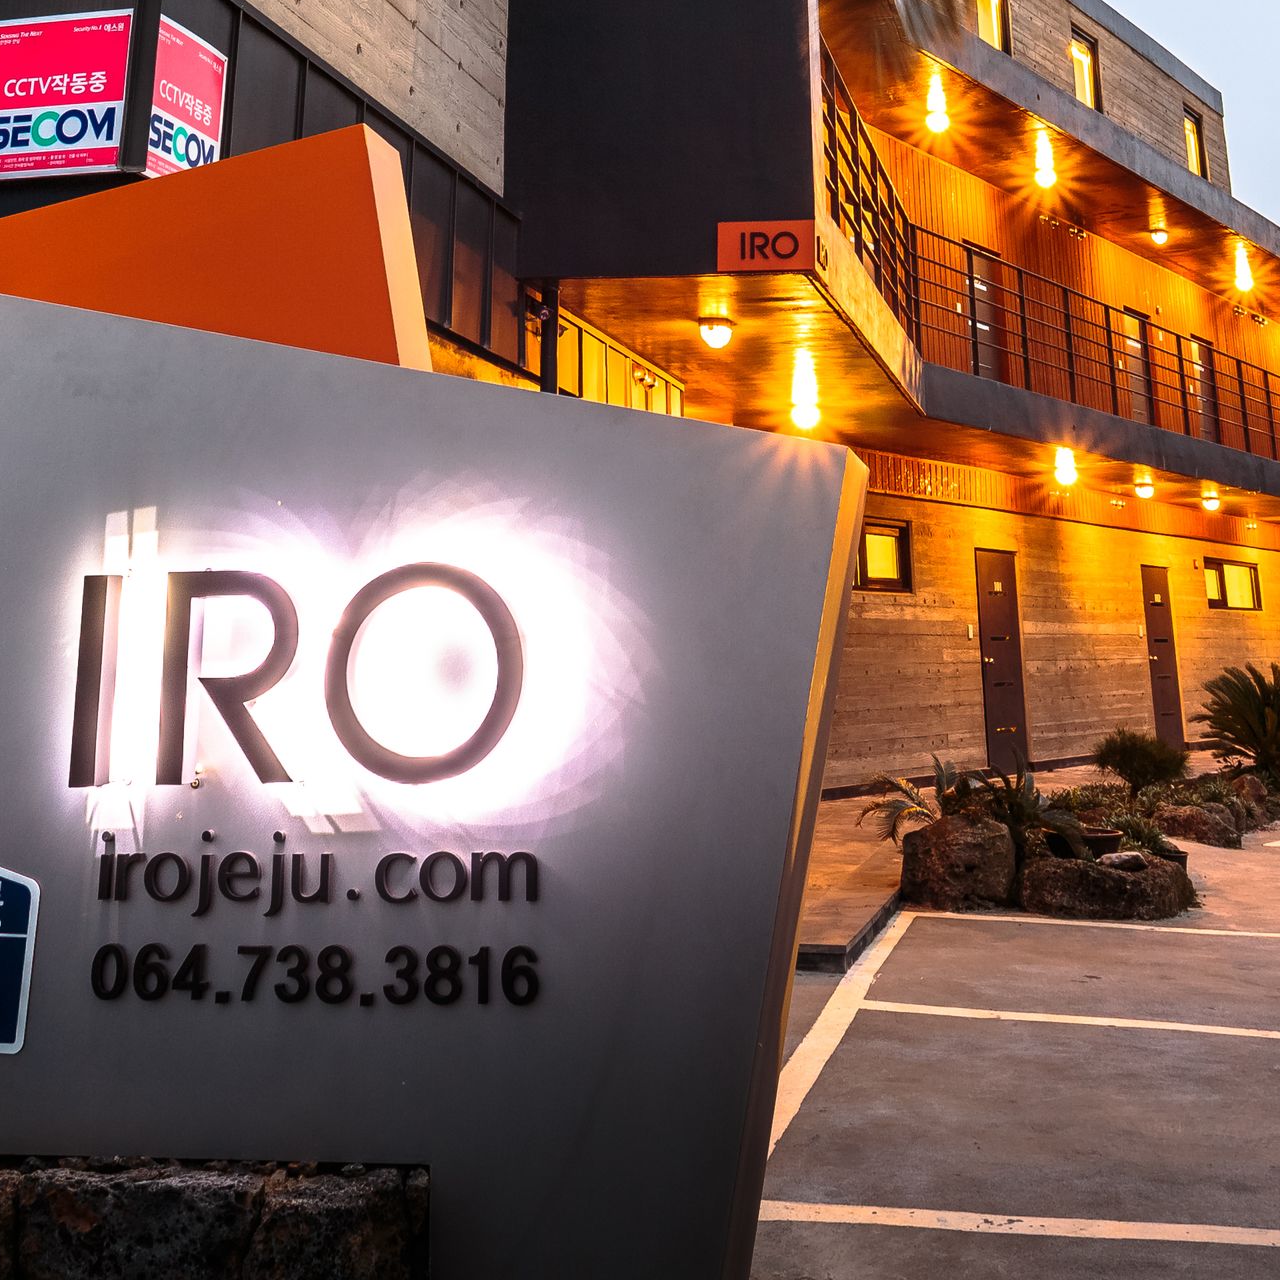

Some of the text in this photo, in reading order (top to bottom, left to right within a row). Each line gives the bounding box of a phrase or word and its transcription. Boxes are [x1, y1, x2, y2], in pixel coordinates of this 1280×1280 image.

[3, 71, 107, 98] CCTV작동중
[159, 79, 212, 127] CCTV작동중
[149, 113, 215, 167] SECOM
[740, 231, 799, 260] IRO
[68, 561, 524, 789] IRO
[97, 830, 540, 918] irojeju.com
[90, 941, 541, 1007] 064.738.3816
